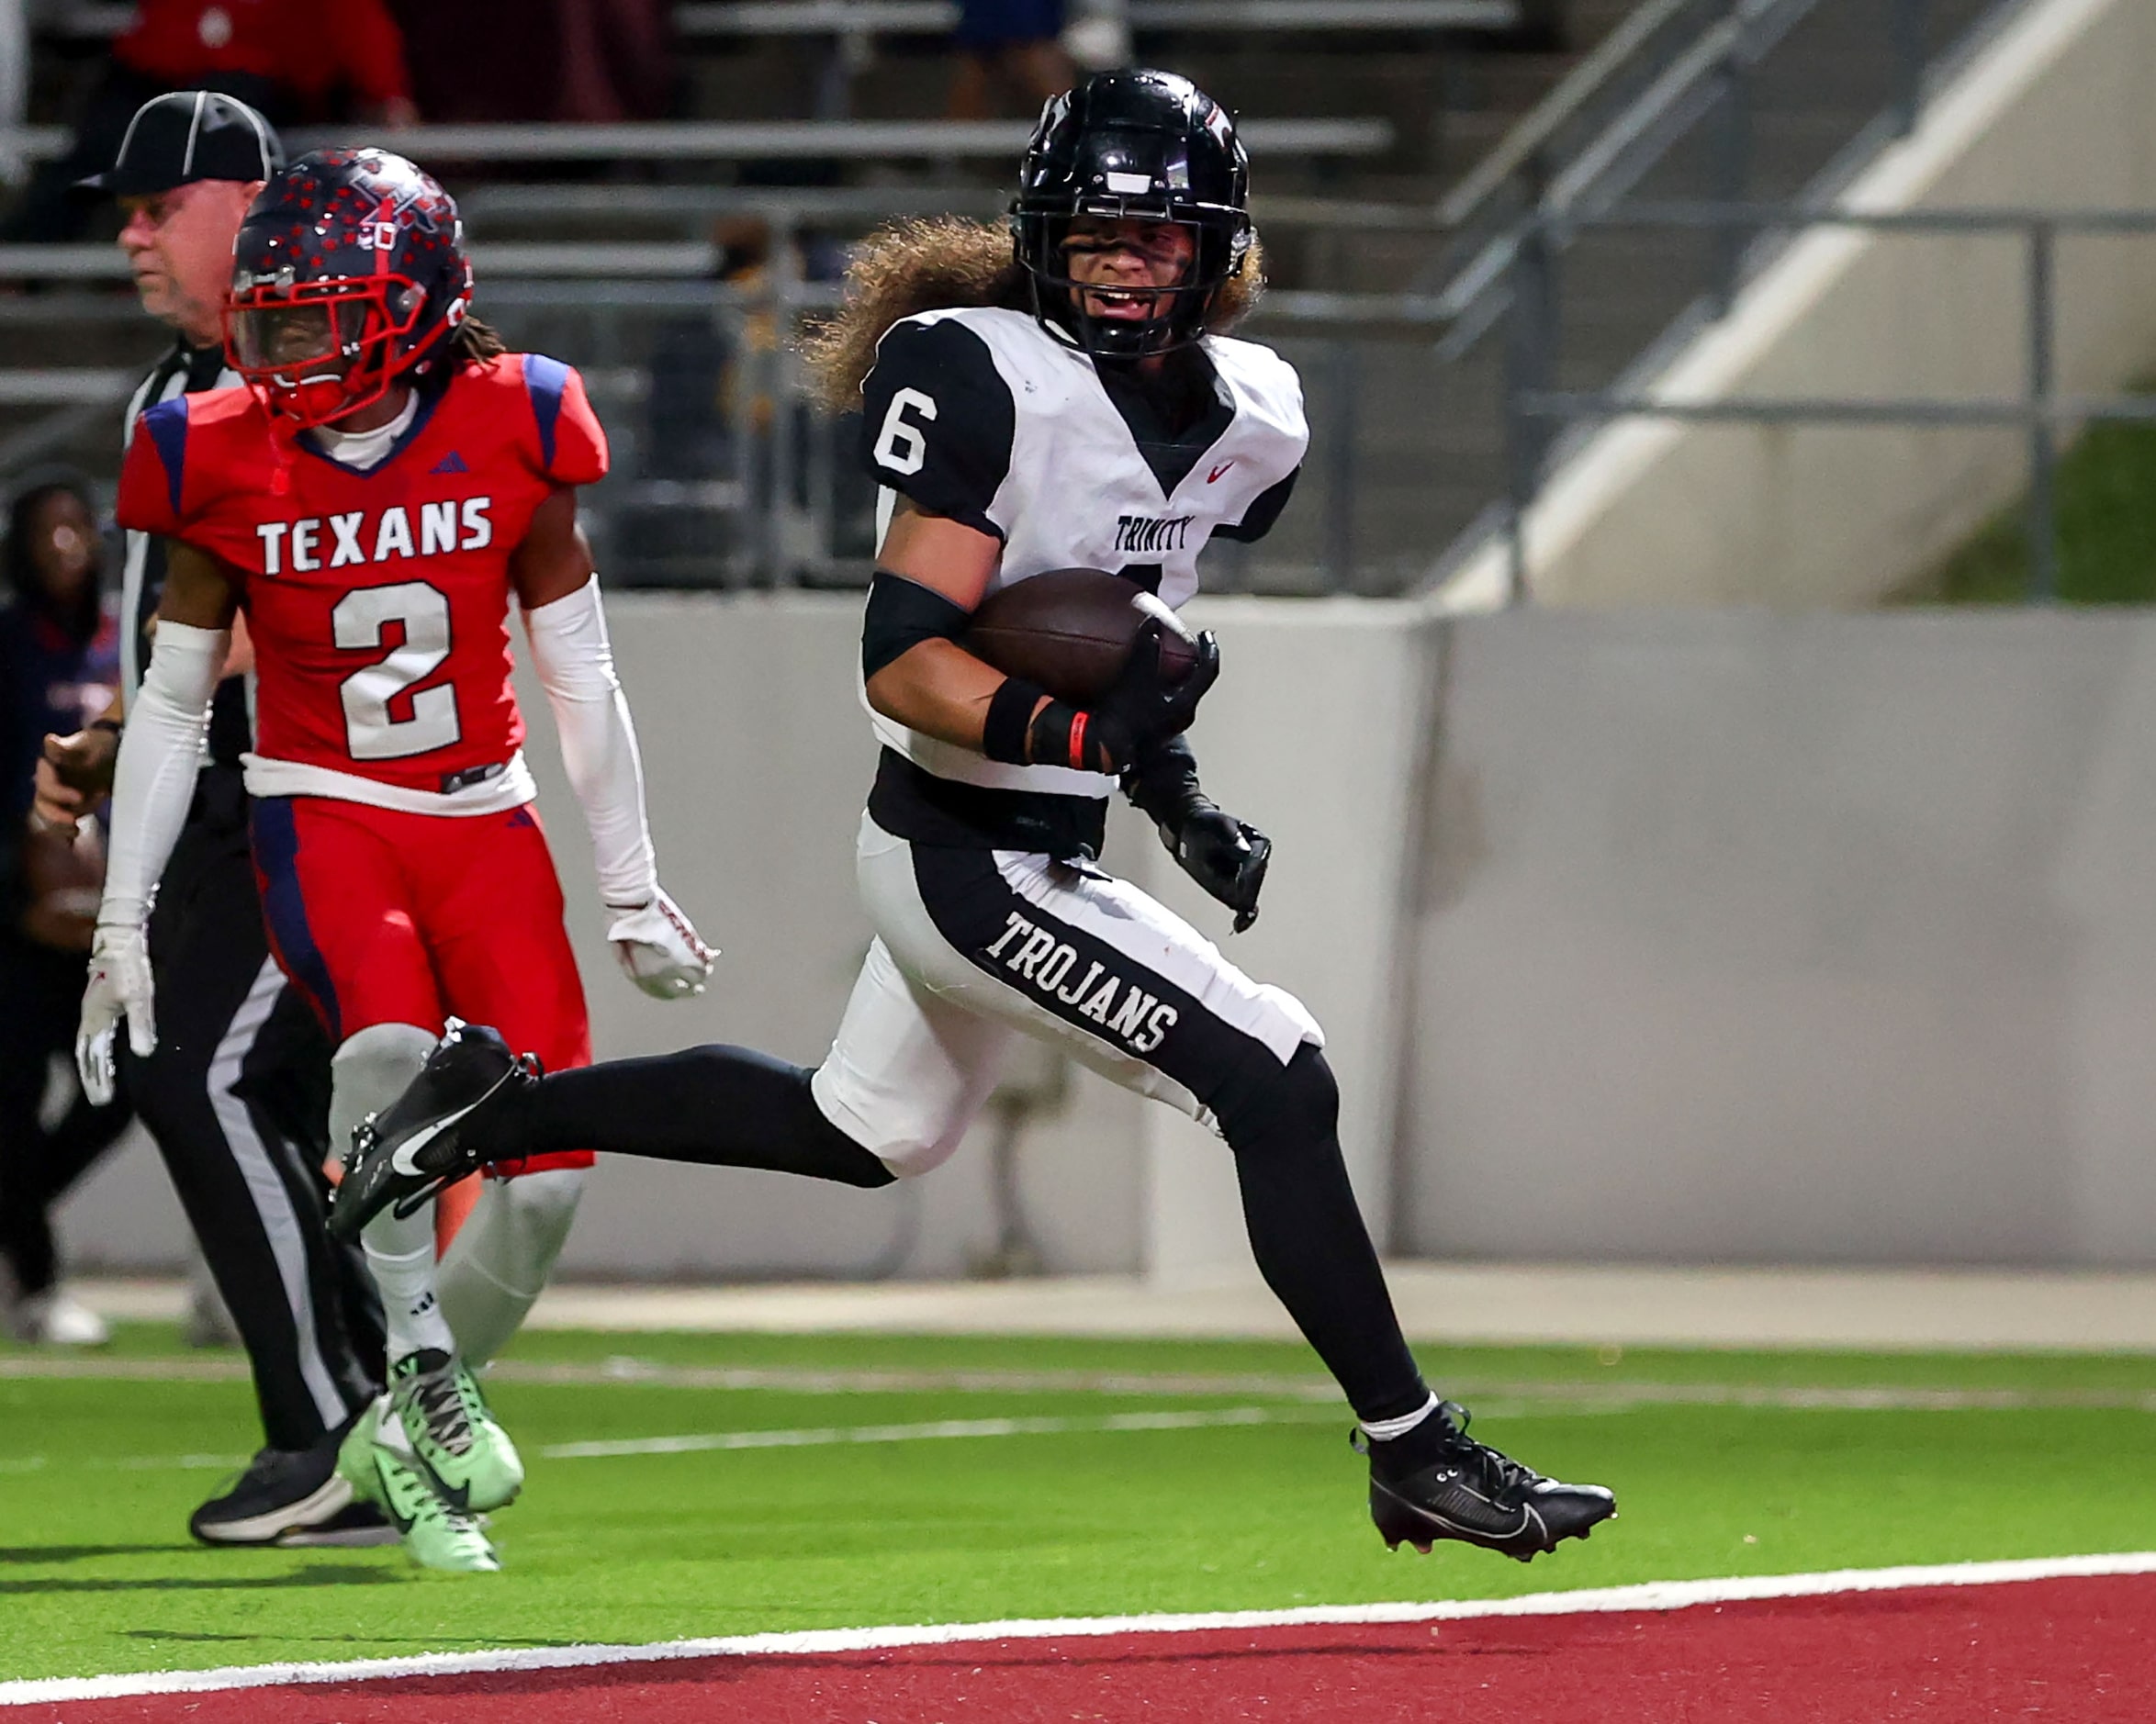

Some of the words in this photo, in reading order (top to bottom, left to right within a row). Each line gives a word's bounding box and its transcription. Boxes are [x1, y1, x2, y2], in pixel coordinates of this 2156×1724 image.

[873, 386, 938, 476] 6
[256, 497, 492, 576] TEXANS
[1115, 515, 1196, 552] TRINITY
[331, 580, 462, 762] 2
[985, 911, 1178, 1053] TROJANS
